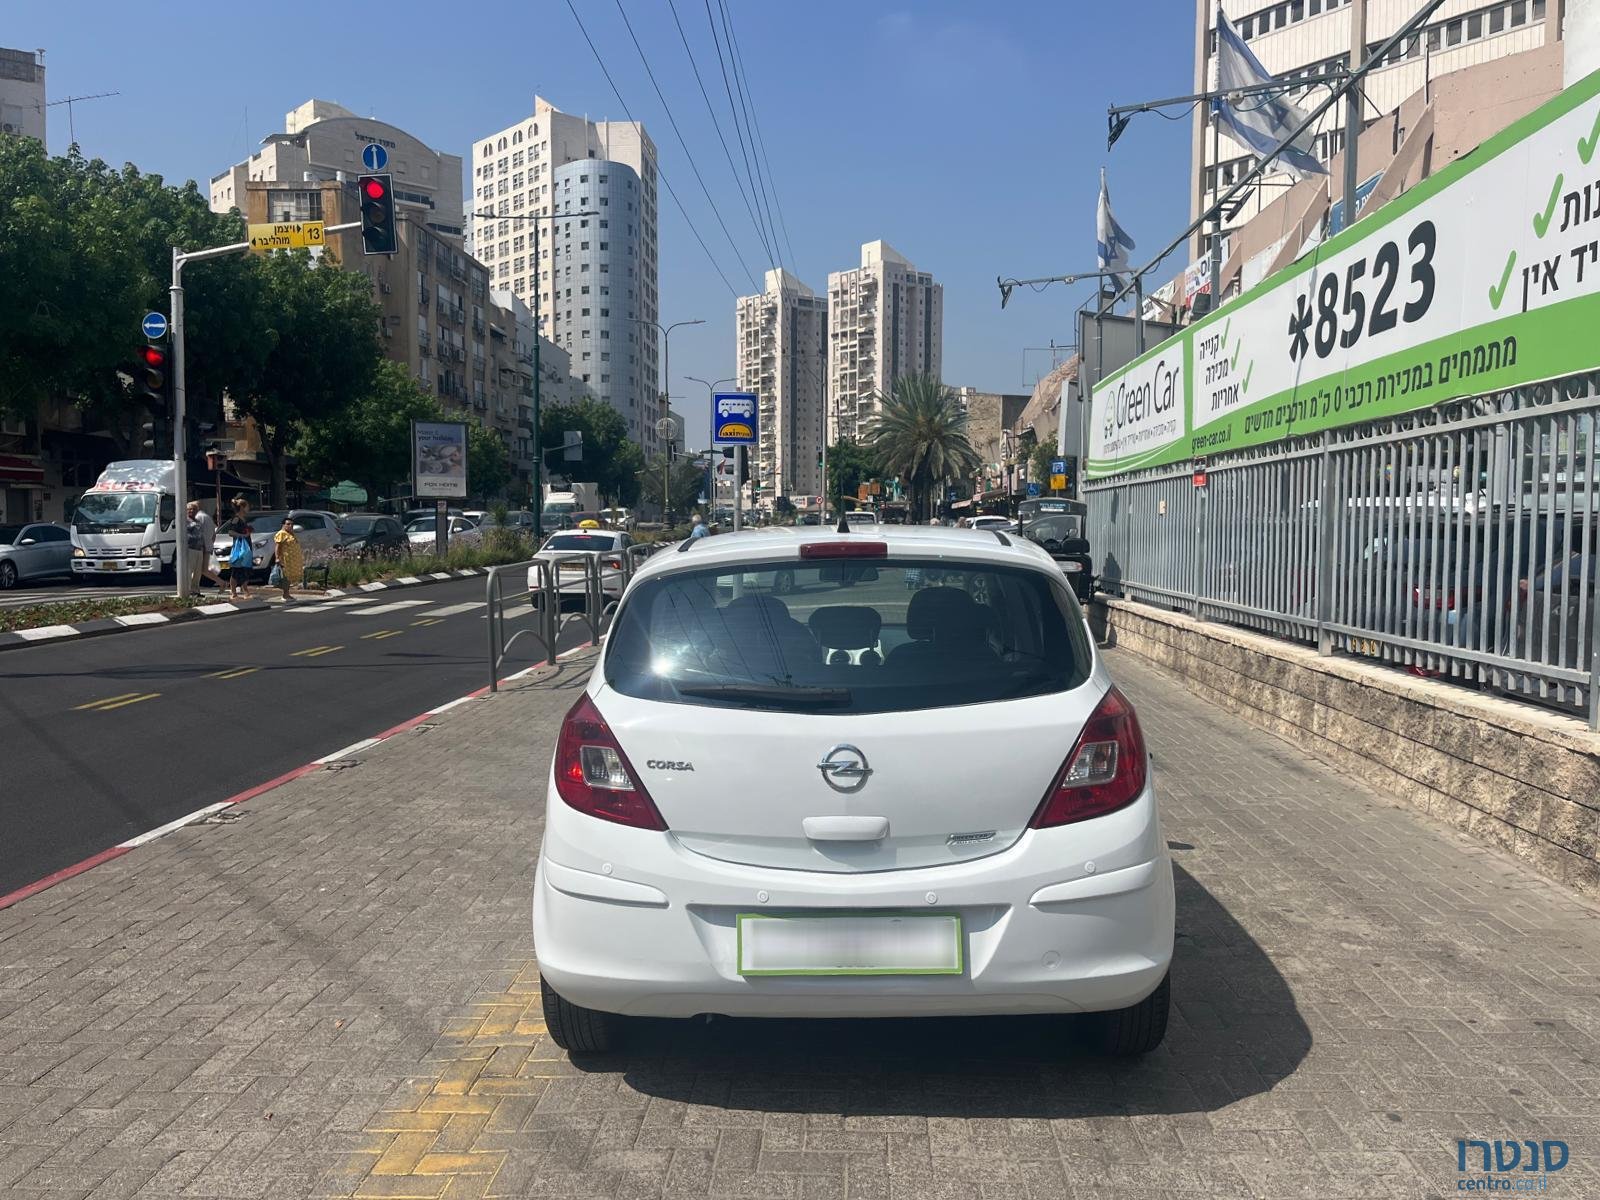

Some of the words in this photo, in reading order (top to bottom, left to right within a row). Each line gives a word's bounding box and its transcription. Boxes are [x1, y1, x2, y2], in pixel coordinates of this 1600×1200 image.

[258, 235, 290, 246] מוהליבר
[274, 225, 295, 235] ויצמן
[307, 228, 320, 240] 13
[1522, 254, 1561, 312] אין
[1200, 334, 1219, 360] קנייה
[1438, 336, 1516, 384] מתמחים
[1206, 358, 1229, 385] מכירה
[1375, 362, 1432, 401] במכירת
[1116, 381, 1151, 429] Green
[1154, 360, 1179, 413] Car
[1212, 383, 1239, 411] אחריות
[1310, 388, 1330, 418] ק"מ
[1334, 385, 1341, 412] 0
[1344, 381, 1372, 410] רכבי
[1245, 410, 1273, 434] חדשים
[1275, 403, 1307, 427] ורכבים
[1192, 423, 1232, 454] green-car.co.il
[647, 760, 695, 772] CORSA
